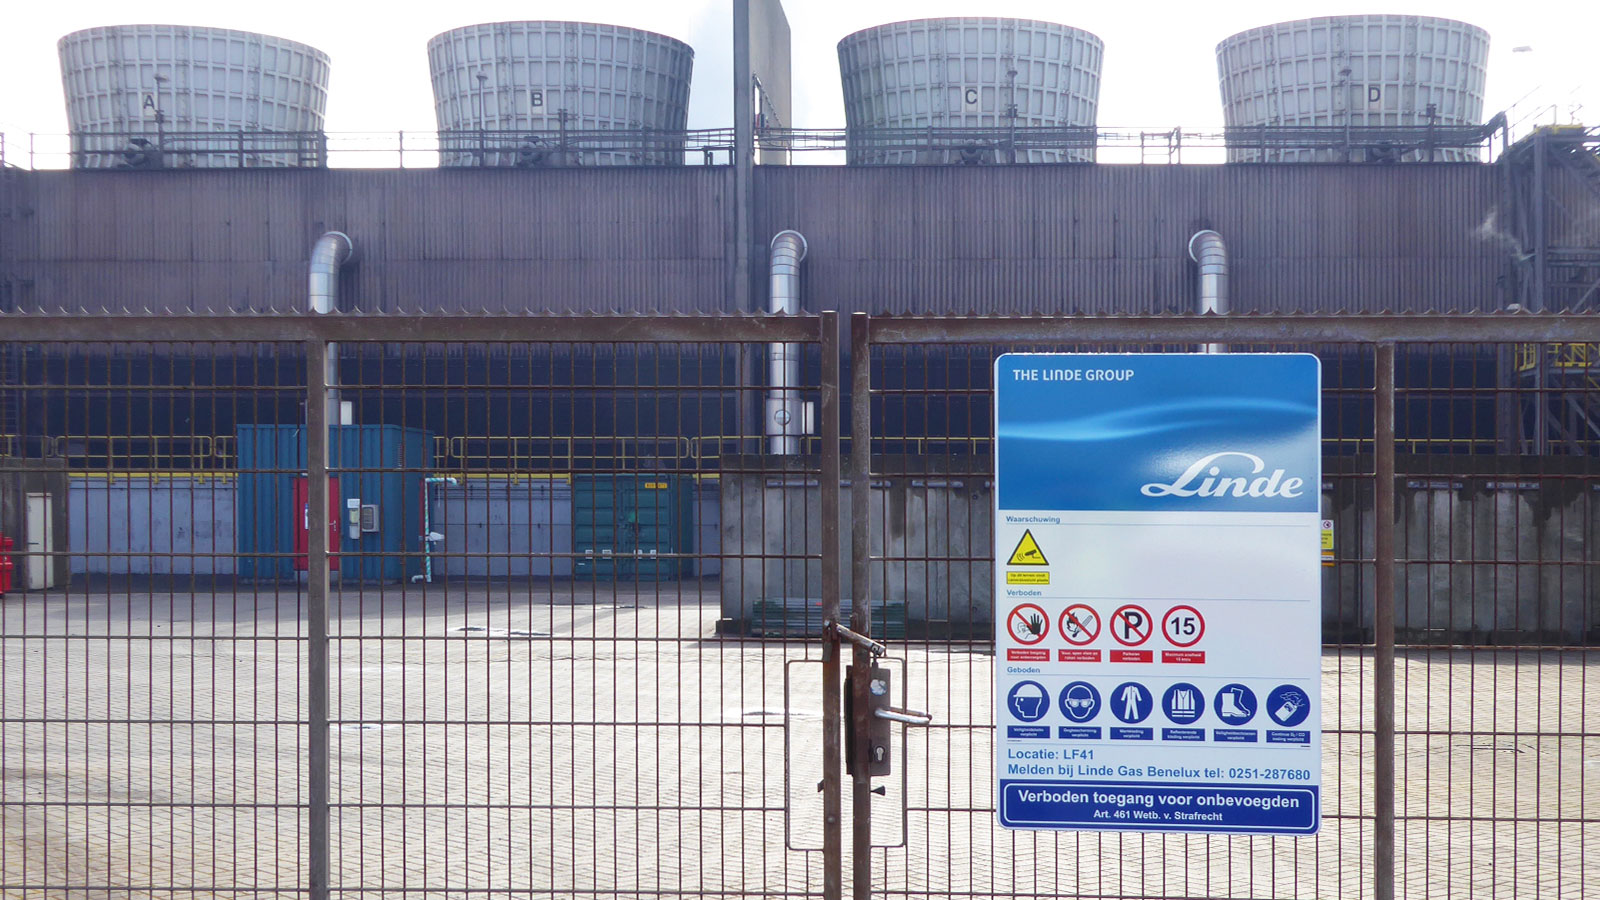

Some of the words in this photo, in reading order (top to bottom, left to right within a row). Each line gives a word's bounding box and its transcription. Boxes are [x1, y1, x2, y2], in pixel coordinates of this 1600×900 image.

[144, 94, 154, 109] A
[532, 92, 542, 106] B
[966, 89, 977, 104] C
[1368, 86, 1380, 102] D
[1013, 369, 1038, 381] THE
[1043, 369, 1082, 381] LINDE
[1085, 369, 1134, 381] GROUP
[1140, 451, 1304, 498] Linde
[1006, 516, 1060, 524] Waarschuwing
[1170, 617, 1196, 635] 15
[1008, 748, 1059, 760] Locatie:
[1063, 749, 1094, 760] LF41
[1008, 764, 1054, 775] Melden
[1058, 764, 1073, 778] bij
[1078, 765, 1113, 776] Linde
[1118, 766, 1143, 776] Gas
[1147, 766, 1201, 777] Benelux
[1204, 768, 1224, 778] tel:
[1229, 768, 1311, 780] 0251-287680
[1018, 790, 1089, 803] Verboden
[1093, 791, 1154, 807] toegang
[1158, 795, 1192, 805] voor
[1197, 794, 1299, 810] onbevoegden
[1093, 810, 1111, 818] Art.
[1113, 810, 1130, 818] 461
[1133, 811, 1160, 819] Wetb.
[1164, 812, 1172, 820] v.
[1174, 812, 1223, 821] Strafrecht
